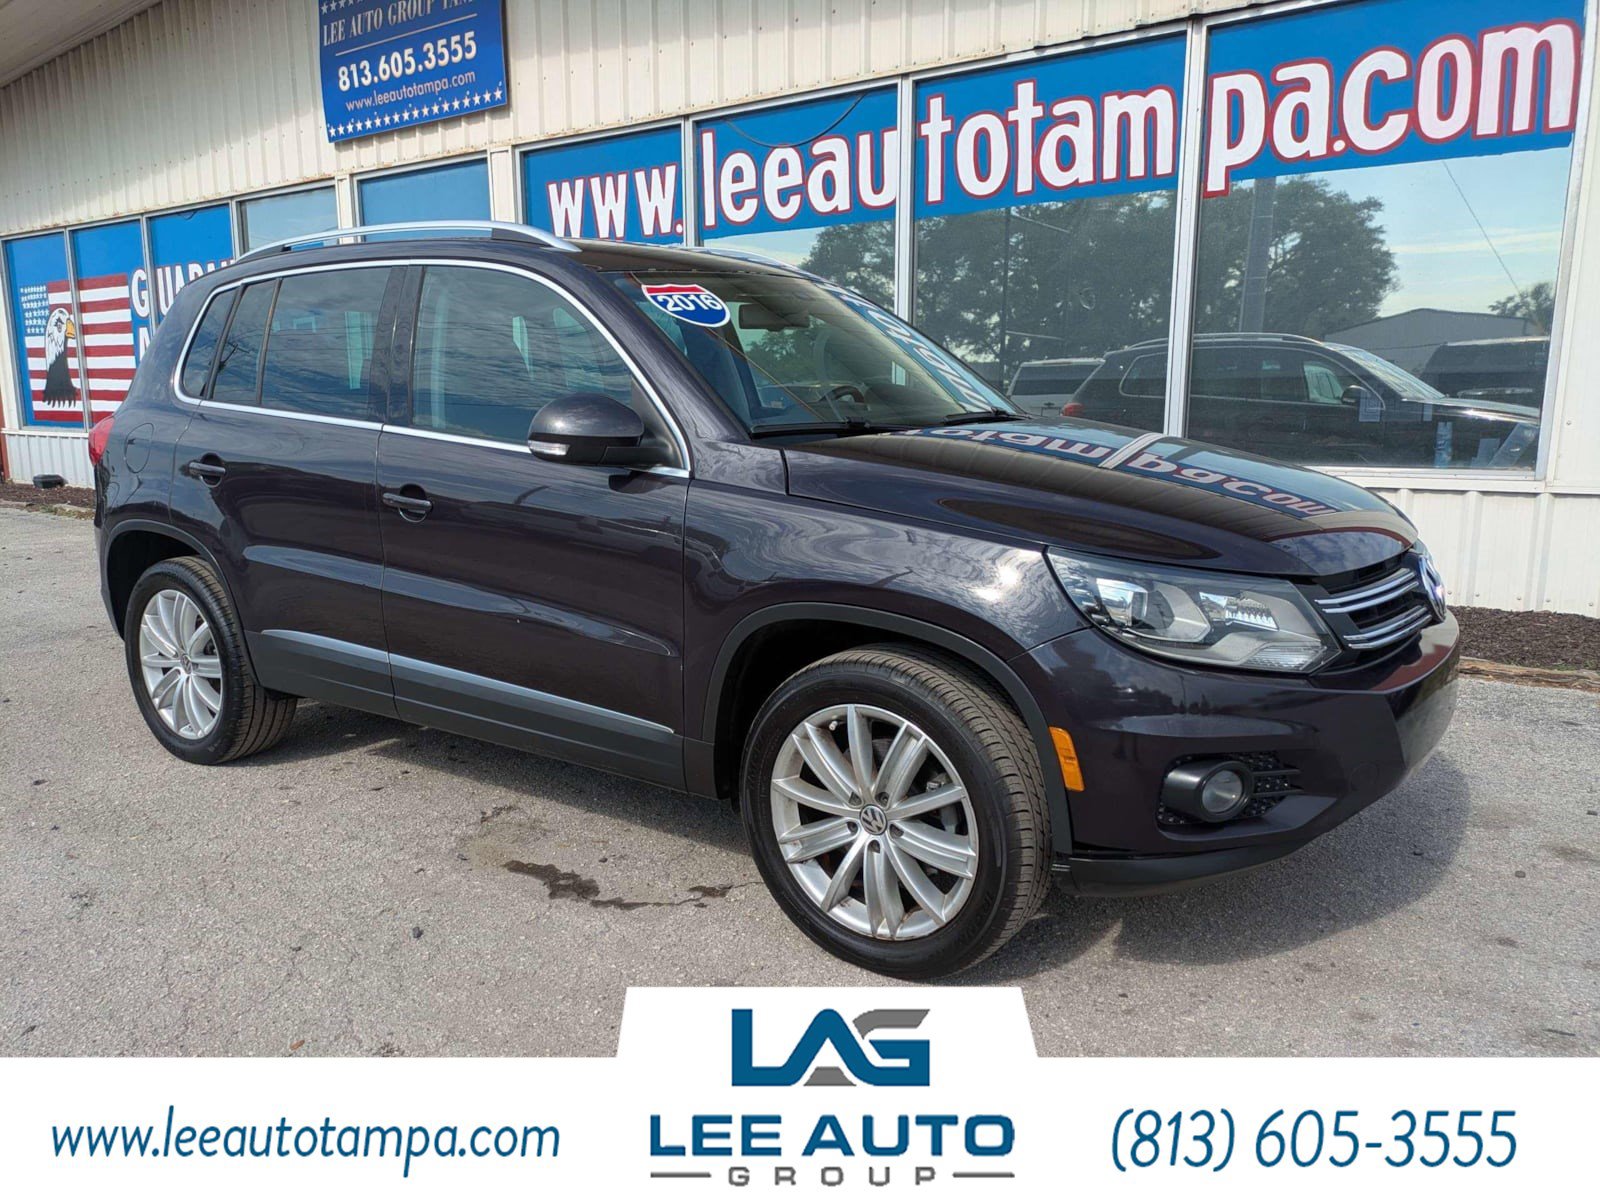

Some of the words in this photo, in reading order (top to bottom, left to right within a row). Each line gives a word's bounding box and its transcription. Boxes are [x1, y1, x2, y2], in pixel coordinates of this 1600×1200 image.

[323, 20, 345, 46] LEE
[350, 11, 383, 38] AUTO
[387, 0, 434, 26] GROUP
[337, 30, 477, 92] 813.605.3555
[345, 71, 476, 112] www.leeautotampa.com
[657, 294, 723, 311] 2016
